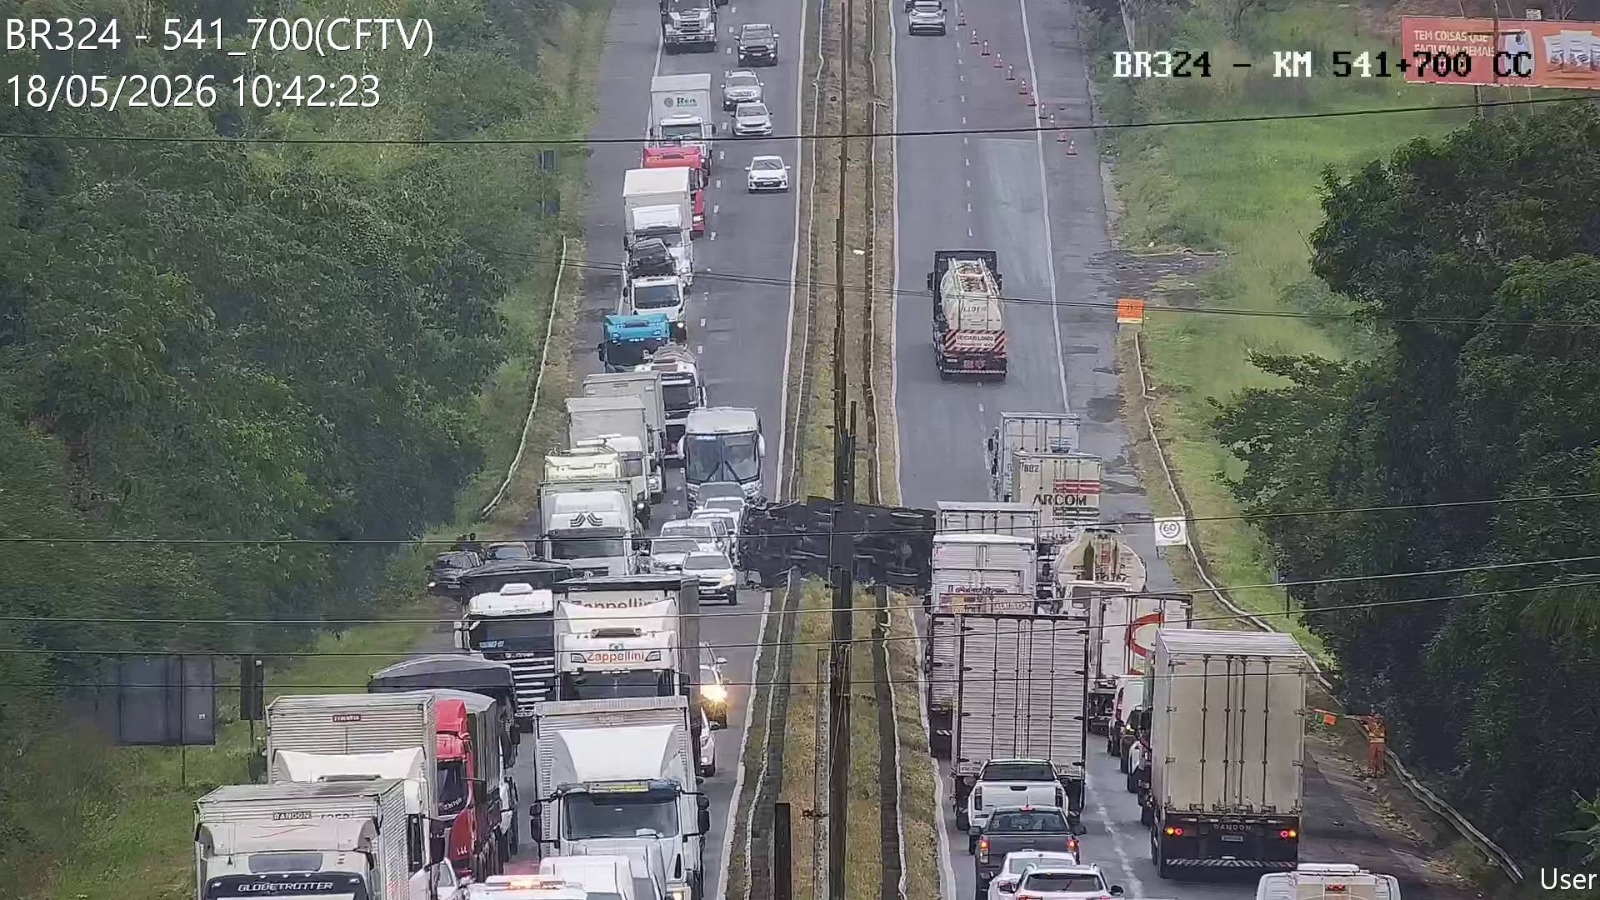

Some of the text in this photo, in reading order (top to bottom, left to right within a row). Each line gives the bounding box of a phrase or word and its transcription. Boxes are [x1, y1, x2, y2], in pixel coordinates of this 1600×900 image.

[1413, 30, 1433, 41] TEM
[1435, 30, 1467, 42] COISAS
[1033, 494, 1086, 506] ARCOM
[1164, 523, 1177, 532] 60
[587, 650, 645, 662] Zappellini
[274, 812, 311, 820] RANDON
[237, 882, 334, 892] GLOBETROTTER
